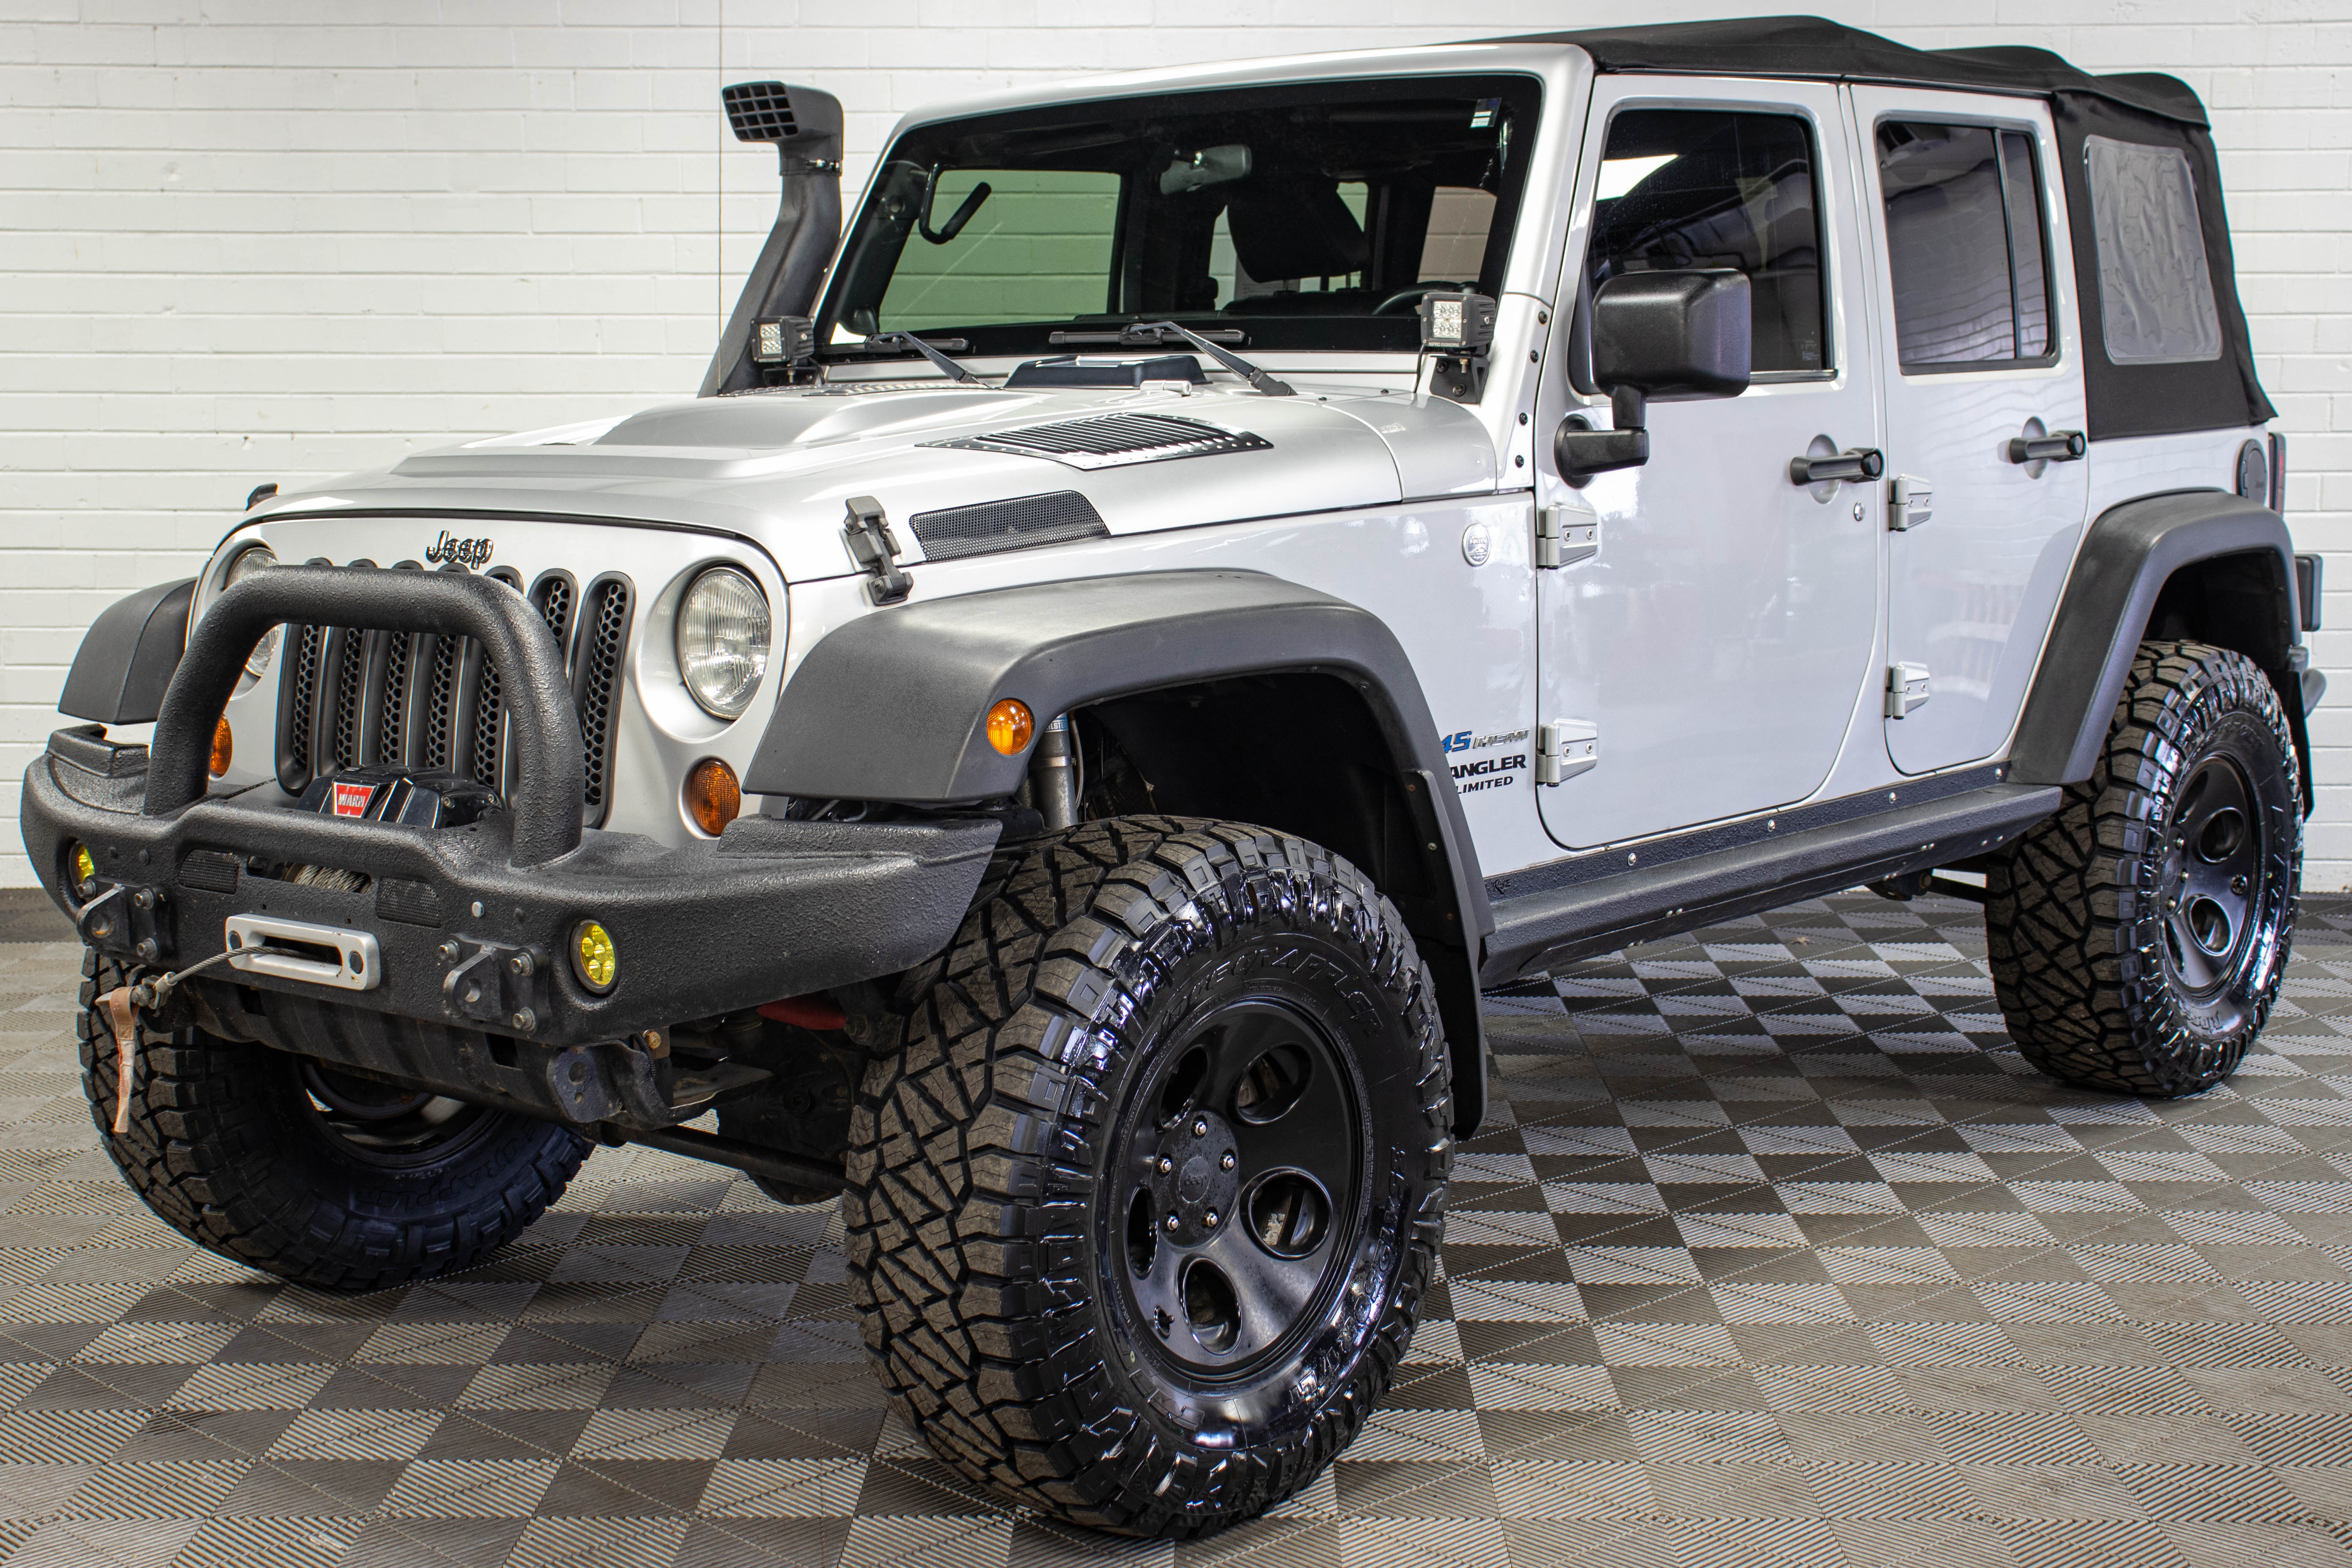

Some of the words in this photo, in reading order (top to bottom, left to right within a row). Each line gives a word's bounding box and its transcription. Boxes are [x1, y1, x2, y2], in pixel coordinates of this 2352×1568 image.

[426, 530, 494, 569] Jeep
[1441, 730, 1472, 753] 45
[1473, 728, 1529, 748] HEMI
[1450, 754, 1527, 778] ANGLER
[1456, 776, 1513, 794] LIMITED
[338, 793, 366, 807] WARN
